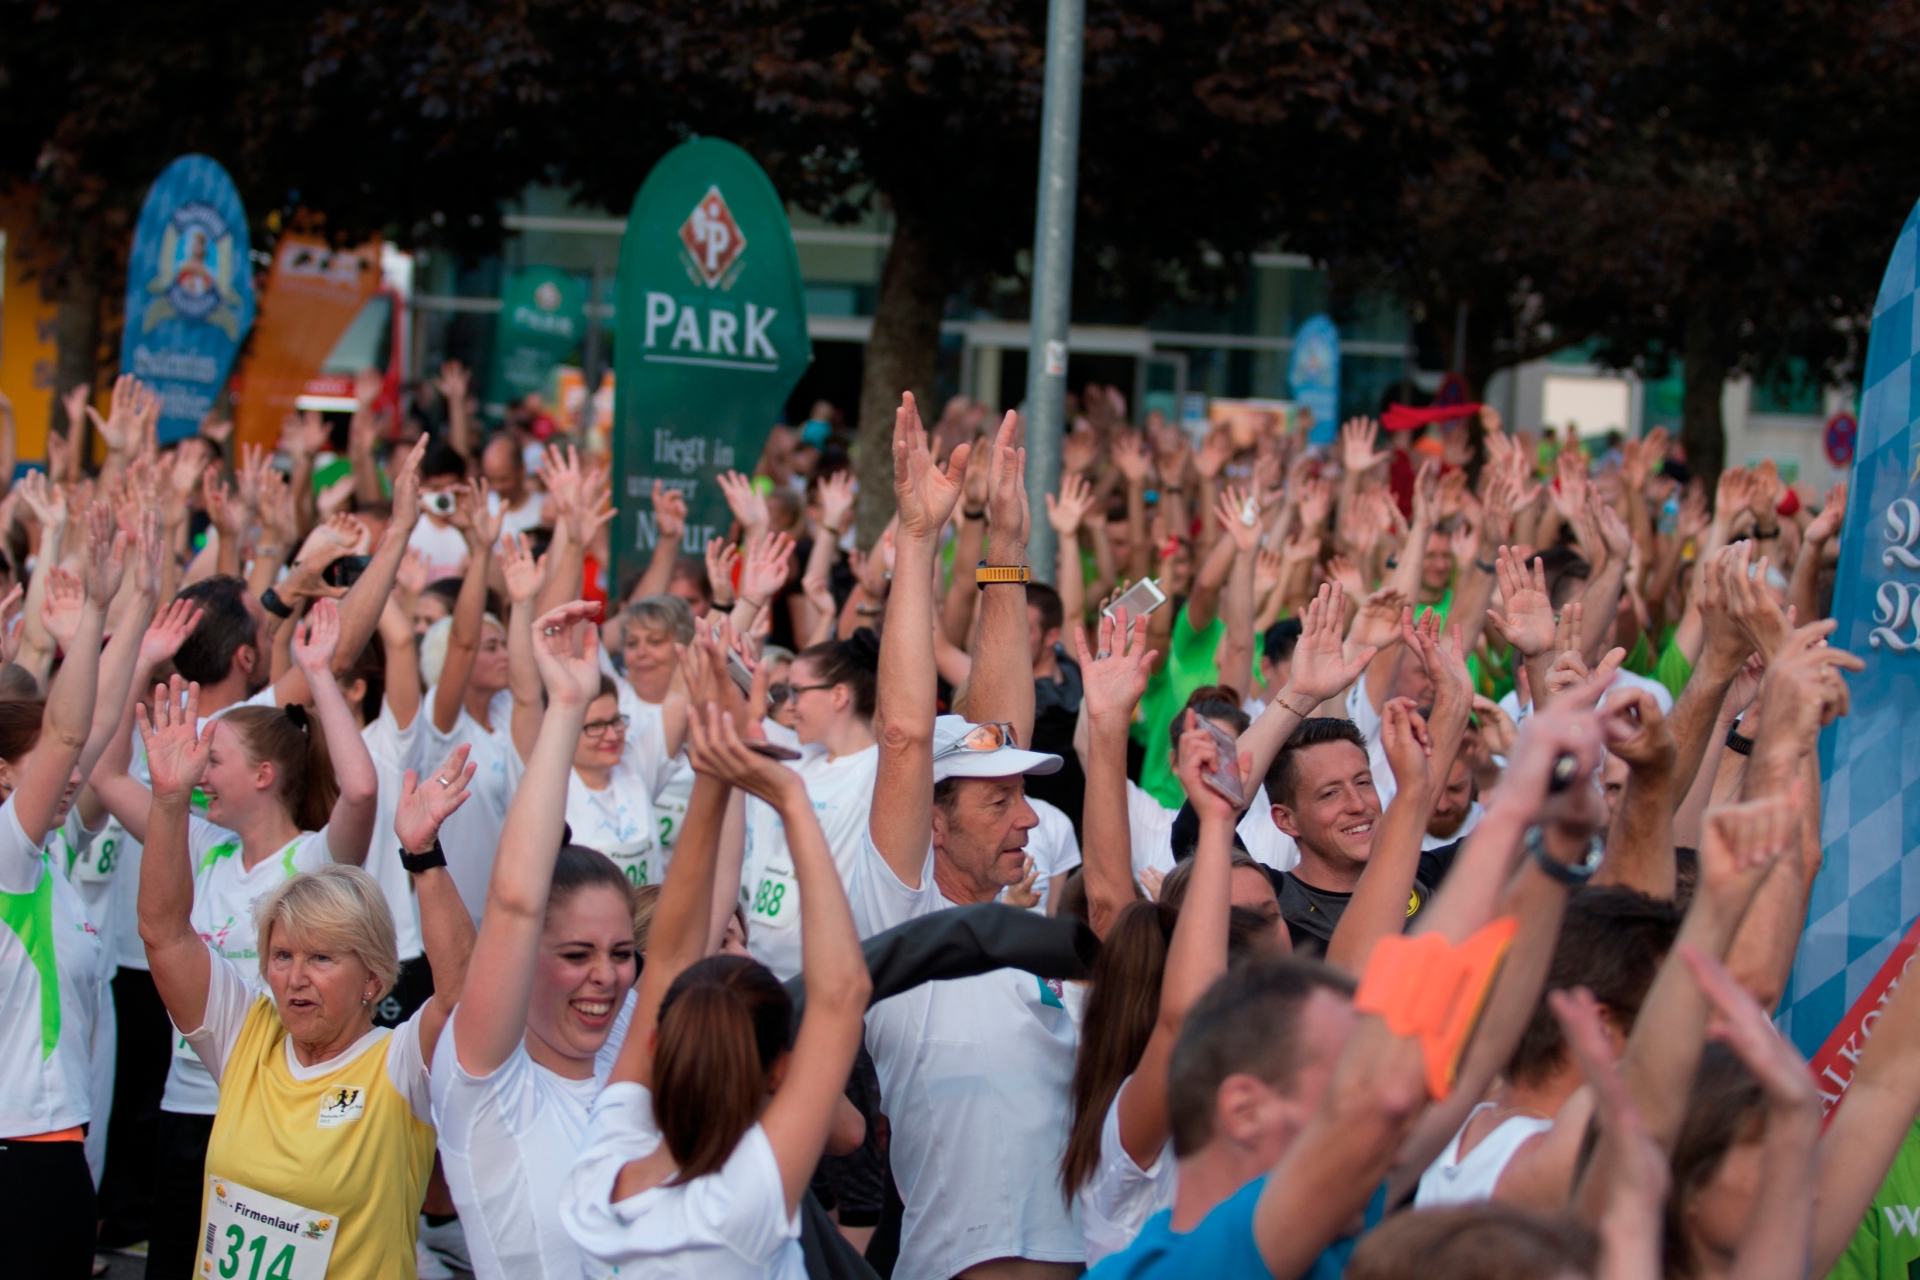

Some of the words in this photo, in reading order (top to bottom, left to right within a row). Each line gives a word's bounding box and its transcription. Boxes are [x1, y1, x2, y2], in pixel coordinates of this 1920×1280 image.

[644, 291, 779, 361] PARK
[654, 428, 706, 474] liegt
[713, 439, 735, 467] in
[636, 510, 716, 554] Nur
[234, 1201, 300, 1234] Firmenlauf
[218, 1223, 297, 1280] 314
